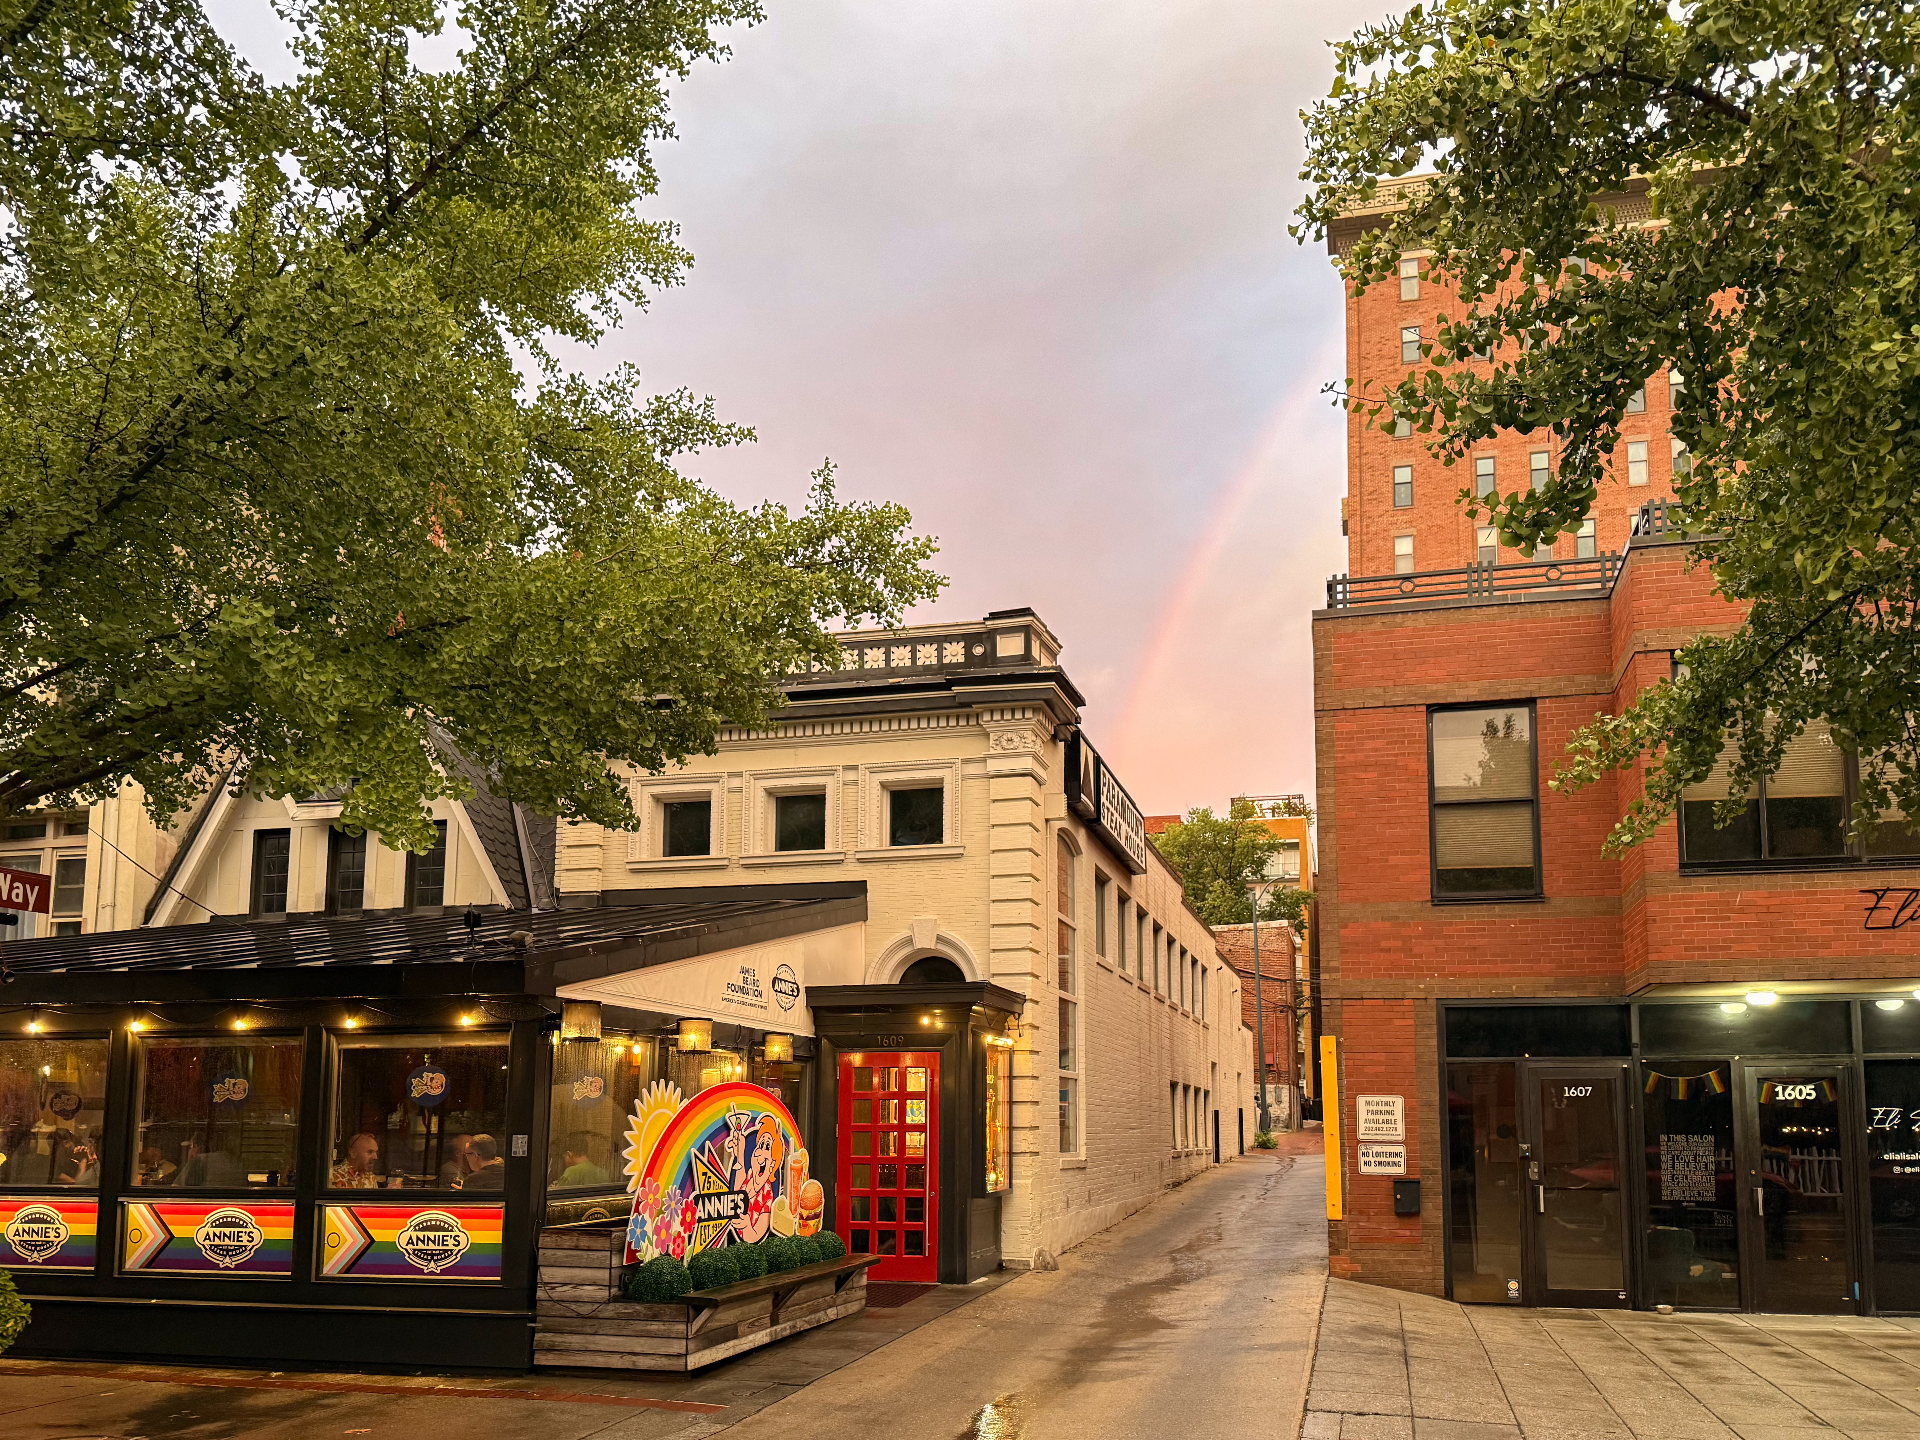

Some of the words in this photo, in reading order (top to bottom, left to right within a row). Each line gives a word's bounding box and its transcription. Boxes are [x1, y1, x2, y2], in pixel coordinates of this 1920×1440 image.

[1102, 770, 1142, 842] PARAMOUNT
[1102, 802, 1122, 841] STEAK
[1124, 831, 1143, 863] HOUSE
[739, 965, 755, 977] JAMES
[743, 976, 760, 988] BEARD
[774, 978, 798, 996] ANNIE'S
[726, 982, 762, 999] FOUNDATION
[877, 1035, 904, 1047] 1609
[1563, 1086, 1592, 1097] 1607
[1774, 1084, 1816, 1100] 1605
[1660, 1134, 1667, 1142] IN
[1669, 1134, 1686, 1142] THIS
[1688, 1134, 1714, 1143] SALON
[1696, 1155, 1714, 1163] HAIR
[1883, 1152, 1920, 1160] elialisal
[1374, 1160, 1402, 1168] SMOKING
[701, 1172, 711, 1191] 75
[696, 1194, 745, 1219] ANNIE'S
[415, 1221, 453, 1230] PARAMOUNT
[13, 1226, 61, 1239] ANNIE'S
[203, 1230, 255, 1243] ANNIE'S
[700, 1224, 712, 1246] EST.
[405, 1234, 460, 1247] ANNIE'S
[414, 1251, 431, 1260] STEAK
[434, 1251, 451, 1260] HOUSE
